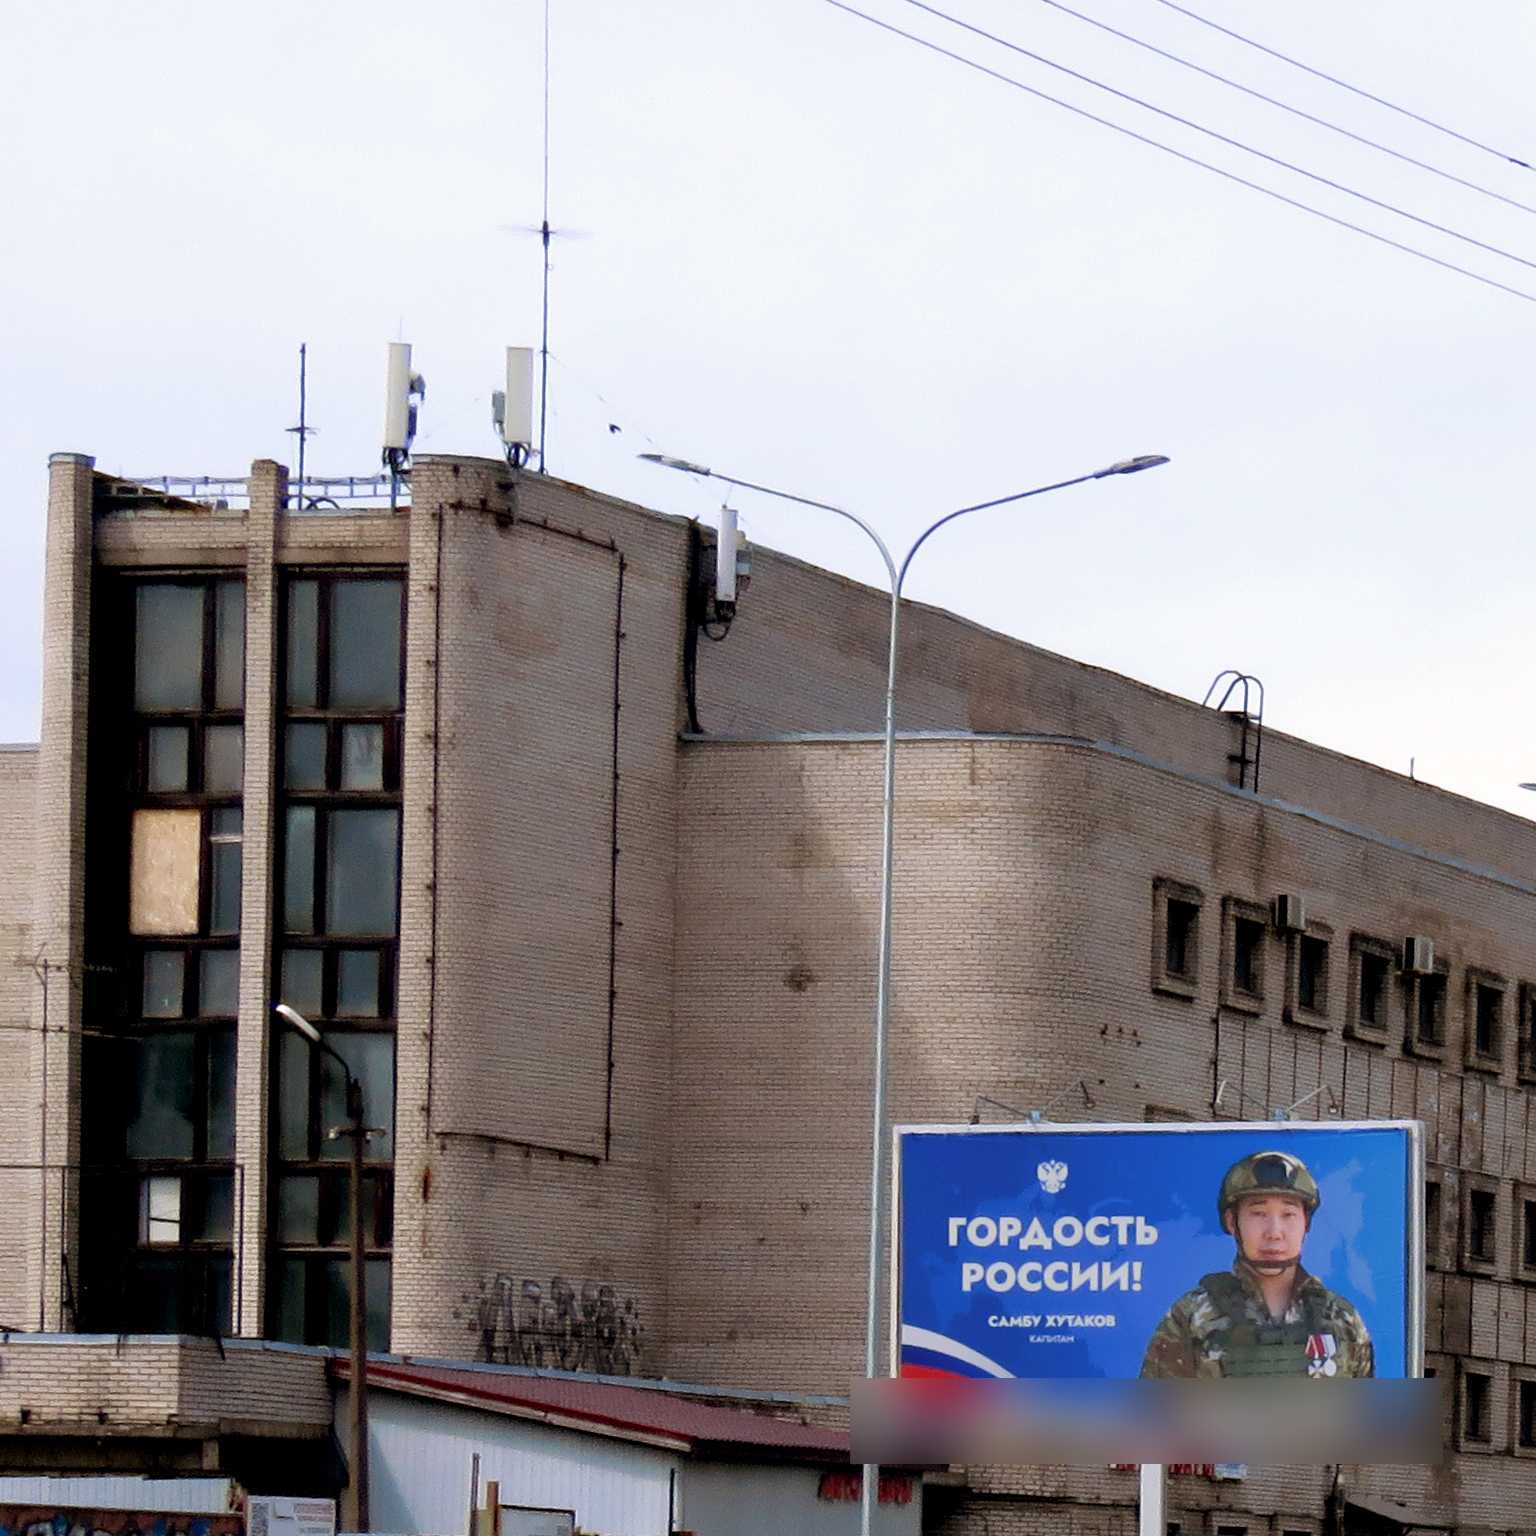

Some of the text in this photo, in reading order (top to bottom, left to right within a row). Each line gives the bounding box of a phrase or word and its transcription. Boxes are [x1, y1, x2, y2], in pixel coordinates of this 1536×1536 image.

[948, 1215, 1159, 1251] ГОРДОСТЬ
[961, 1261, 1143, 1293] РОССИИ!
[988, 1314, 1117, 1328] САМБУ ХУТАКОВ
